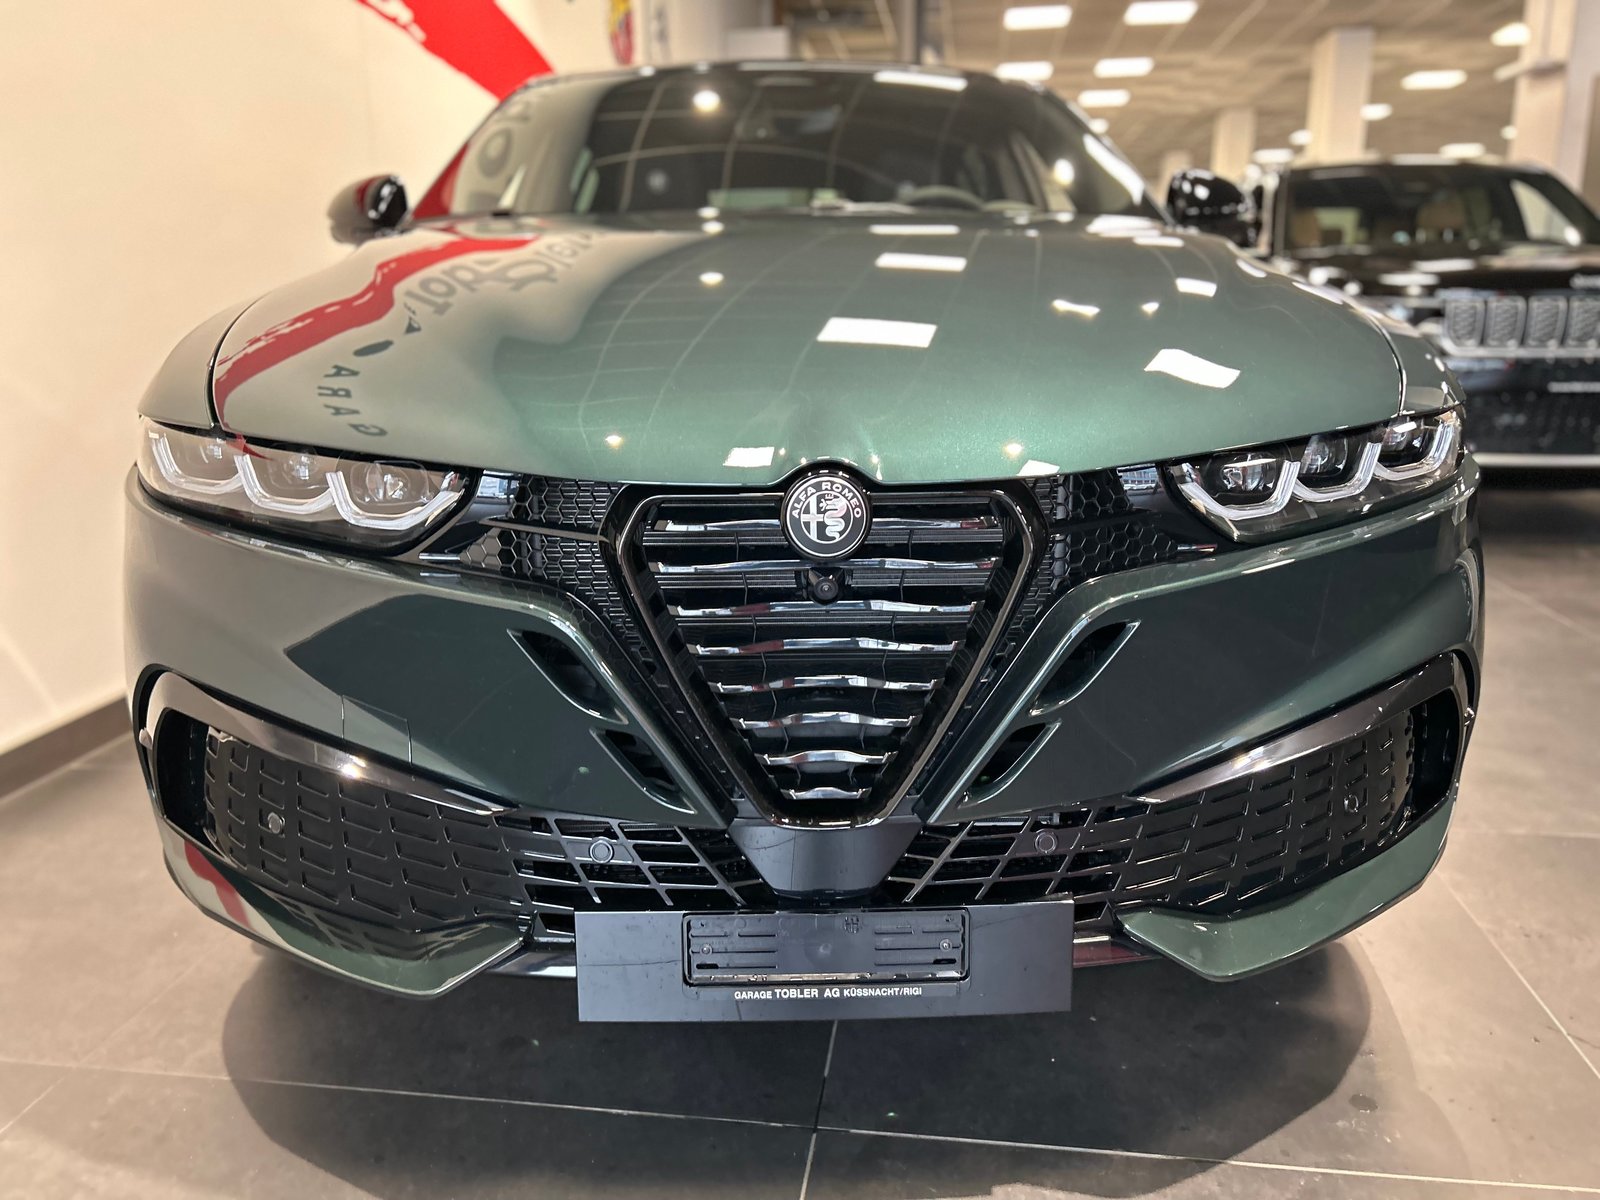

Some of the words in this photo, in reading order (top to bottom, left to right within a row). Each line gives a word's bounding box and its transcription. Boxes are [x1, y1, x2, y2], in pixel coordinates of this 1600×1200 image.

[791, 485, 817, 519] ALFA
[821, 481, 862, 519] ROMEO
[734, 990, 773, 1000] GARAGE
[774, 988, 819, 999] TOBLER
[823, 987, 840, 998] AG
[843, 986, 922, 997] KÜSSNACHT/RIGI
